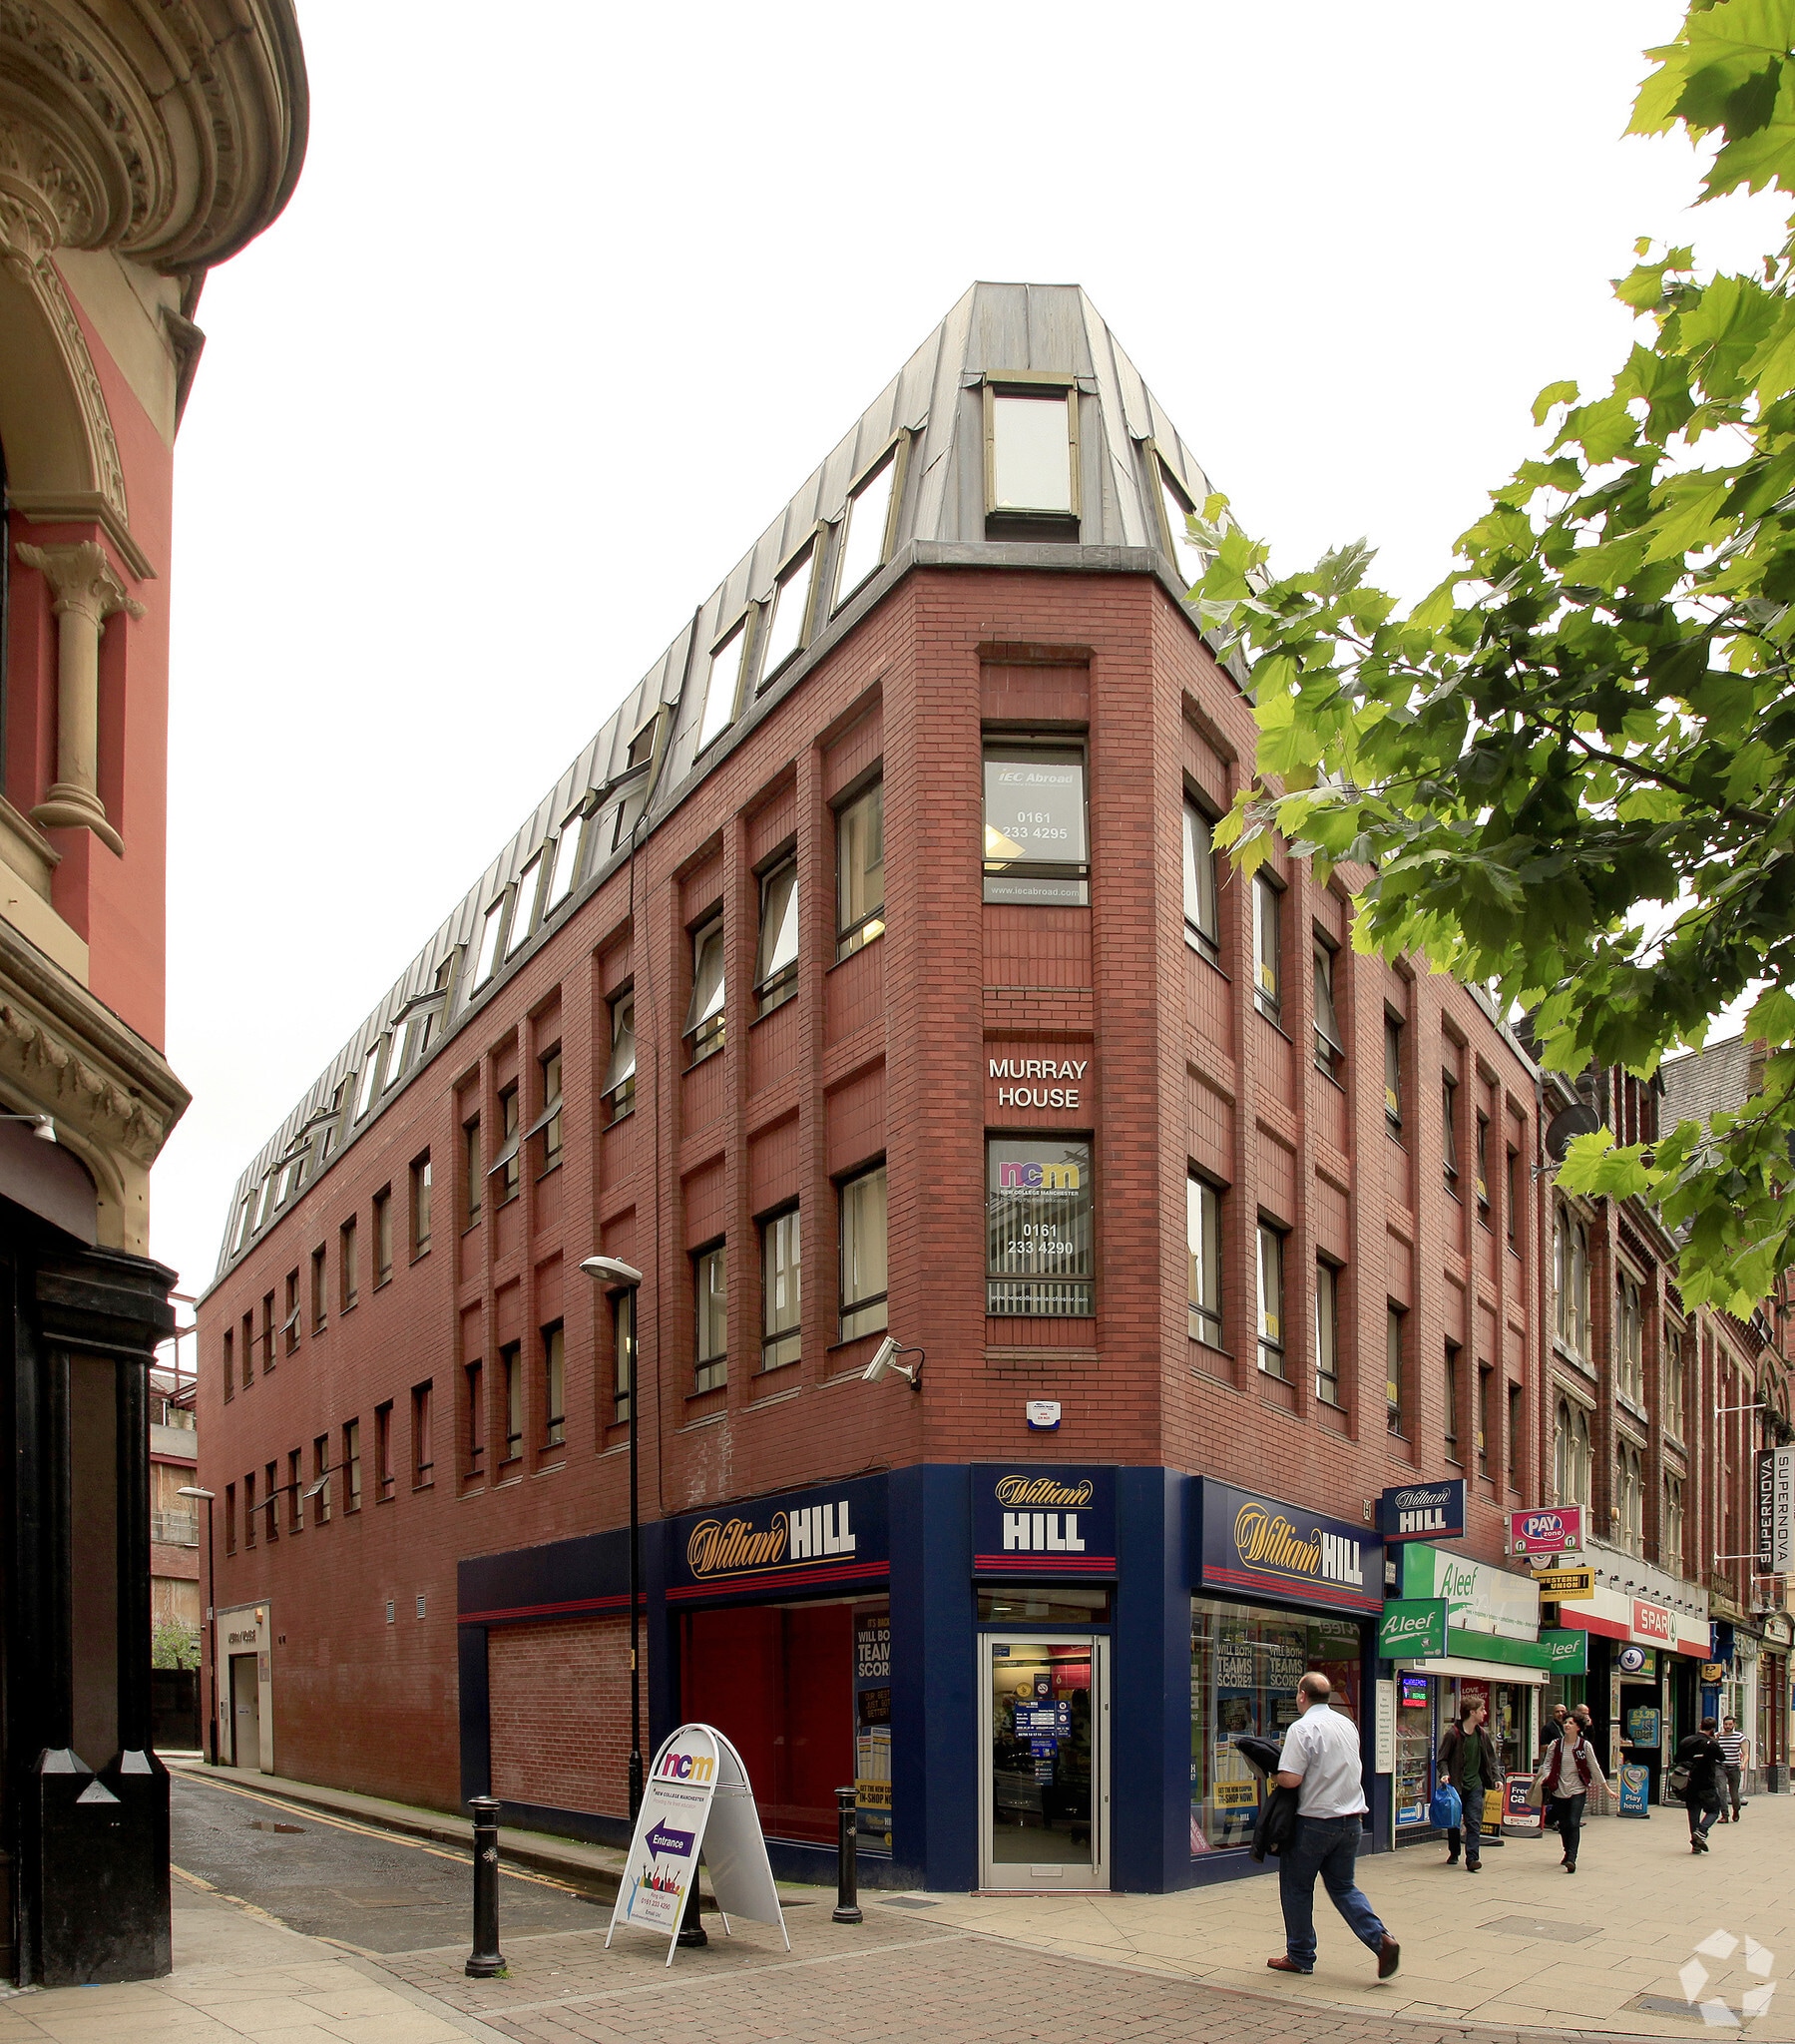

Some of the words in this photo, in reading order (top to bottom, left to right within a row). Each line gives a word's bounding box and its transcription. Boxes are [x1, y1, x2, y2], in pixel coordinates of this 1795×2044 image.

[1026, 772, 1074, 783] Abroad
[1017, 811, 1051, 823] 0161
[1003, 826, 1029, 838] 233
[1032, 827, 1068, 839] 4295
[989, 1059, 1088, 1080] MURRAY
[999, 1087, 1080, 1109] HOUSE
[1000, 1162, 1080, 1189] ncm
[1024, 1225, 1057, 1238] 0161
[1008, 1242, 1034, 1255] 233
[1038, 1243, 1074, 1256] 4290
[995, 1475, 1093, 1509] William
[1395, 1487, 1451, 1509] William
[1761, 1458, 1772, 1564] SUPERNOVA
[1778, 1456, 1789, 1563] SUPERNOVA
[1399, 1508, 1447, 1533] HILL
[1528, 1515, 1557, 1535] PAY
[686, 1511, 789, 1580] William
[789, 1500, 856, 1560] HILL
[1003, 1512, 1086, 1551] HILL
[1234, 1502, 1324, 1577] William
[1322, 1531, 1364, 1586] HILL
[1440, 1562, 1479, 1597] Aleef
[1379, 1611, 1437, 1636] Aleef
[1641, 1608, 1668, 1635] SPAR
[858, 1631, 876, 1642] WILL
[878, 1630, 890, 1641] BO
[858, 1643, 890, 1661] TEAM
[1216, 1645, 1234, 1655] WILL
[1235, 1646, 1252, 1657] BOTH
[1269, 1647, 1286, 1657] WILL
[859, 1662, 890, 1677] SCOR
[1217, 1657, 1252, 1674] TEAMS
[1270, 1657, 1303, 1674] TEAMS
[1217, 1674, 1253, 1688] SCORE?
[663, 1754, 713, 1782] ncm
[860, 1793, 883, 1804] IN-SHOP
[1511, 1794, 1526, 1803] ca
[653, 1834, 683, 1849] Entrance
